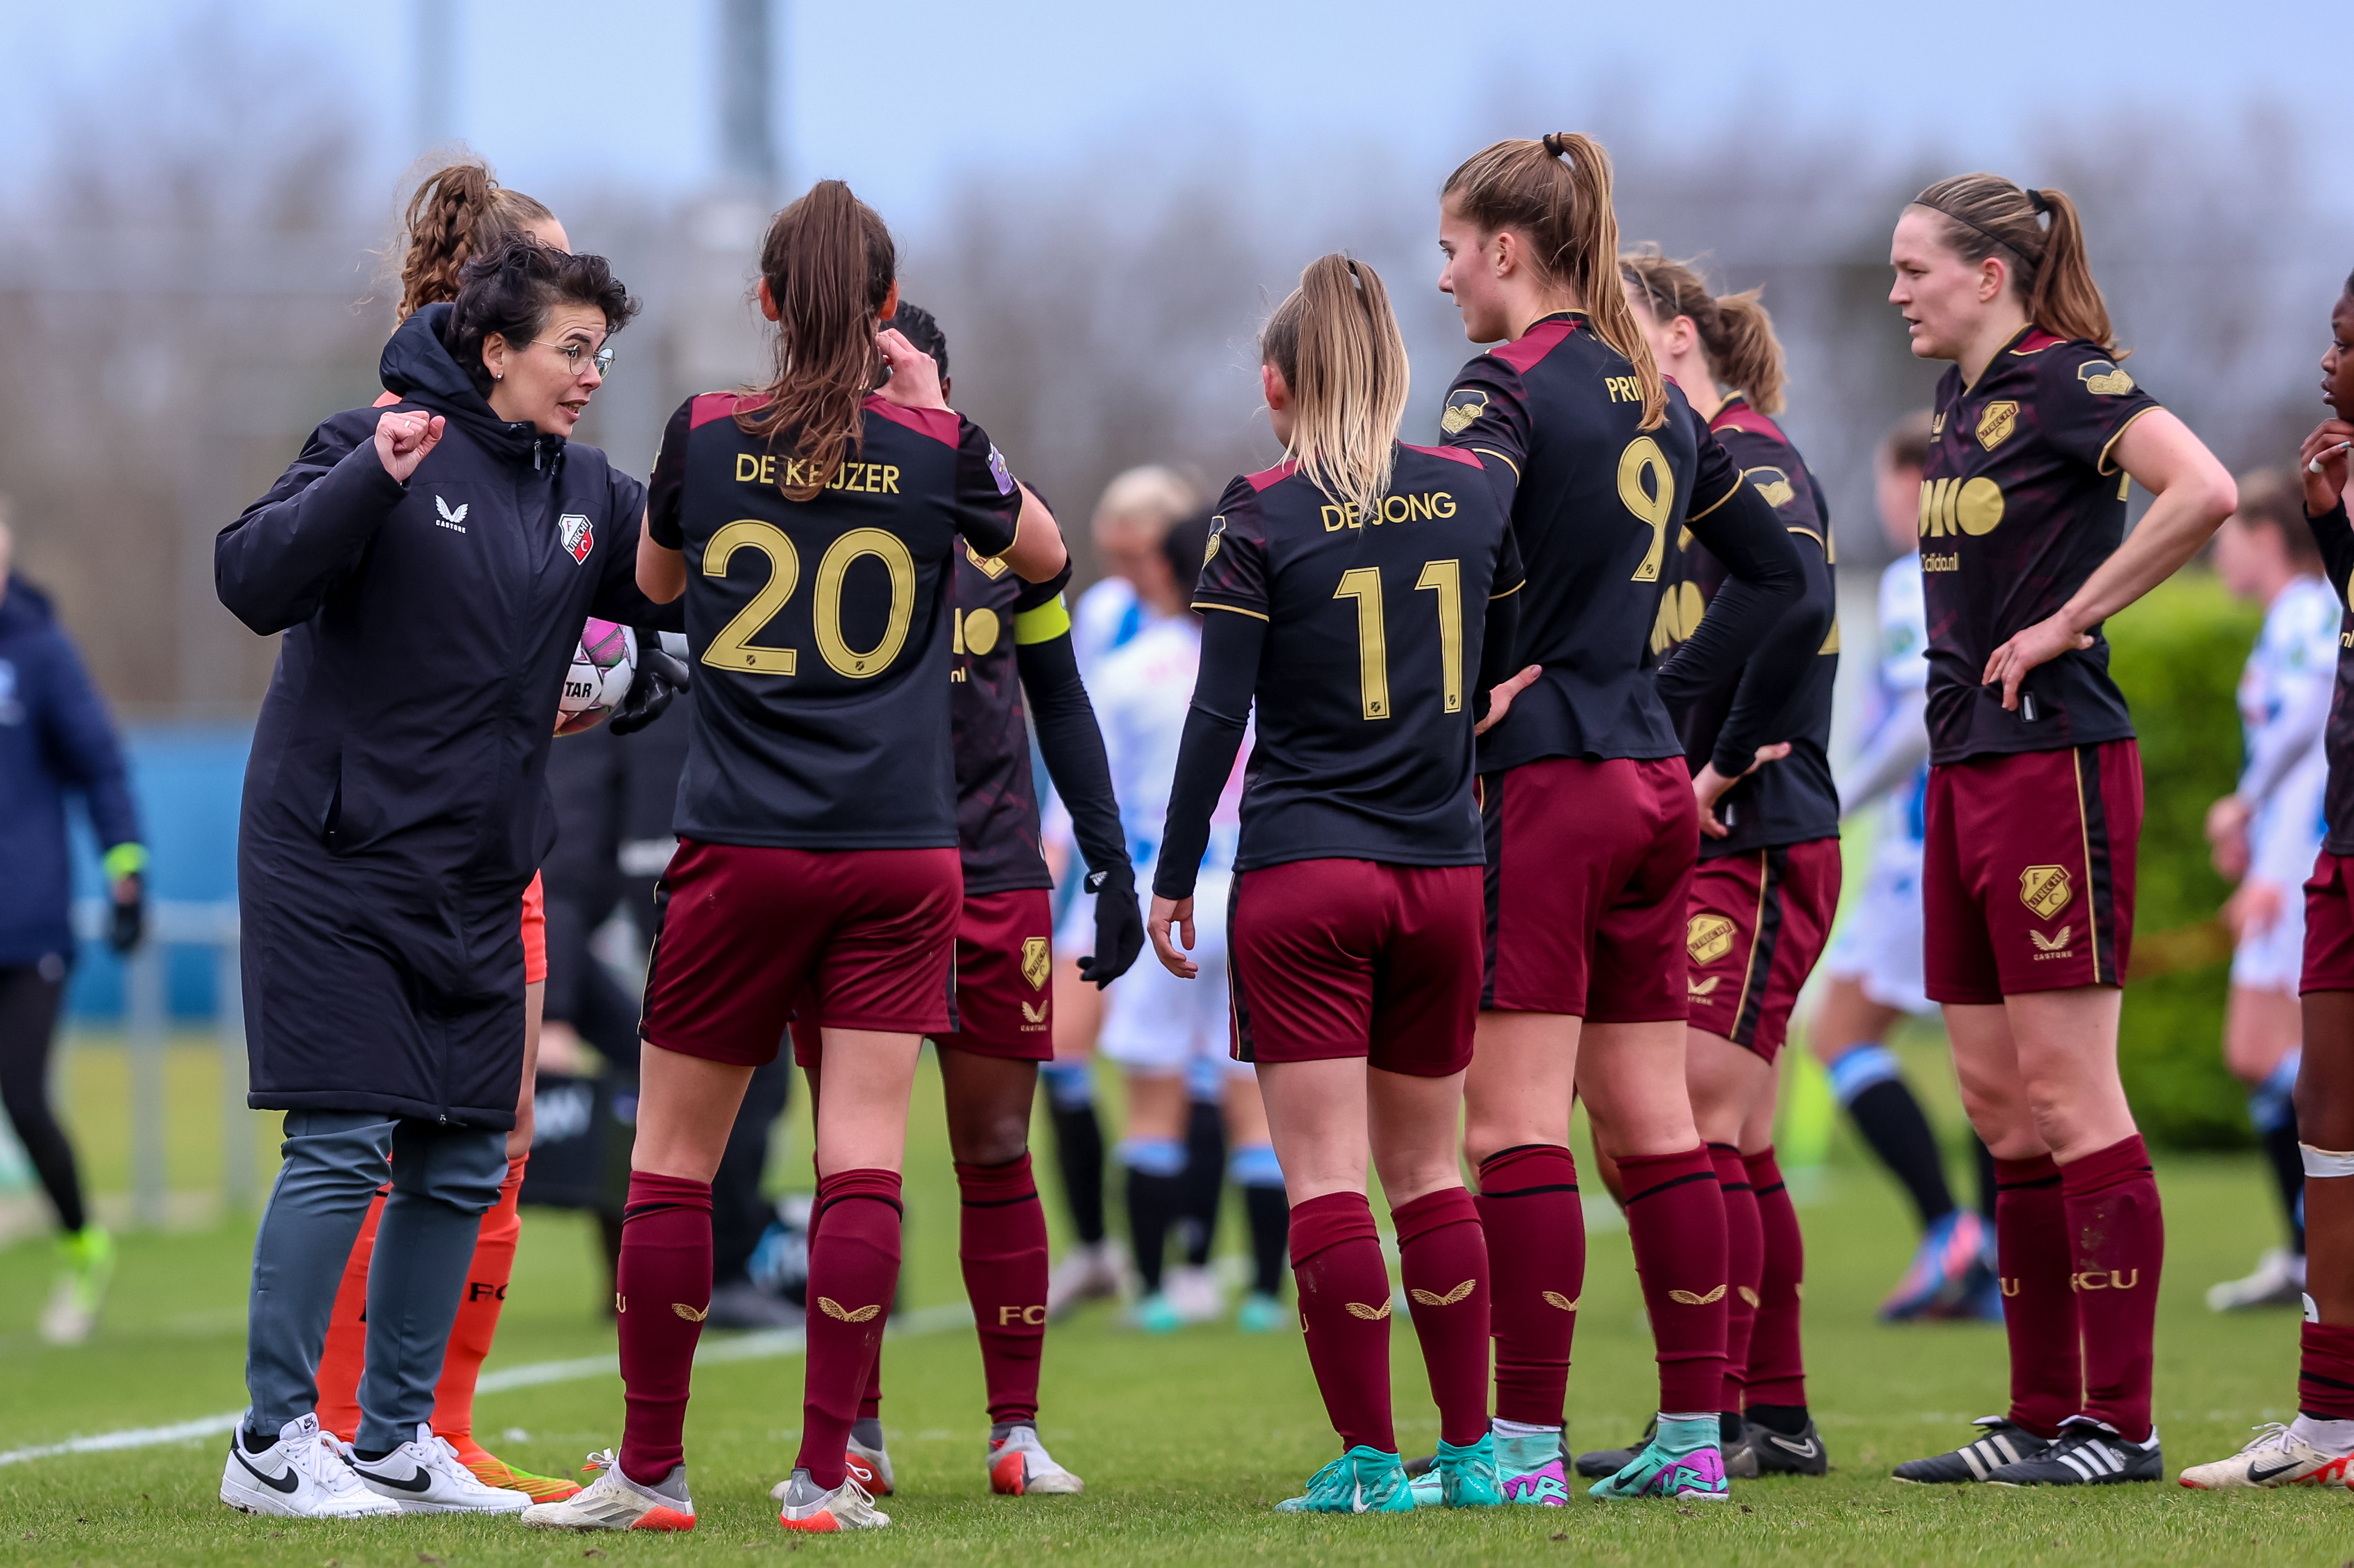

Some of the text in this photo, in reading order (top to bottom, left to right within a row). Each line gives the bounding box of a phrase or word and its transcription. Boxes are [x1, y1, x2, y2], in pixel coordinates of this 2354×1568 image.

[736, 453, 899, 494] DE KEJZER
[1321, 492, 1456, 532] DE JONG
[1617, 436, 1675, 582] 9
[436, 520, 466, 534] CASTORE
[566, 520, 572, 532] F
[567, 520, 589, 552] UTRECHT
[581, 540, 588, 552] C
[701, 519, 916, 679] 20
[1333, 559, 1462, 720] 11
[565, 682, 592, 697] TAR
[1998, 1277, 2020, 1297] U
[616, 1292, 626, 1313] U
[999, 1305, 1046, 1326] FC
